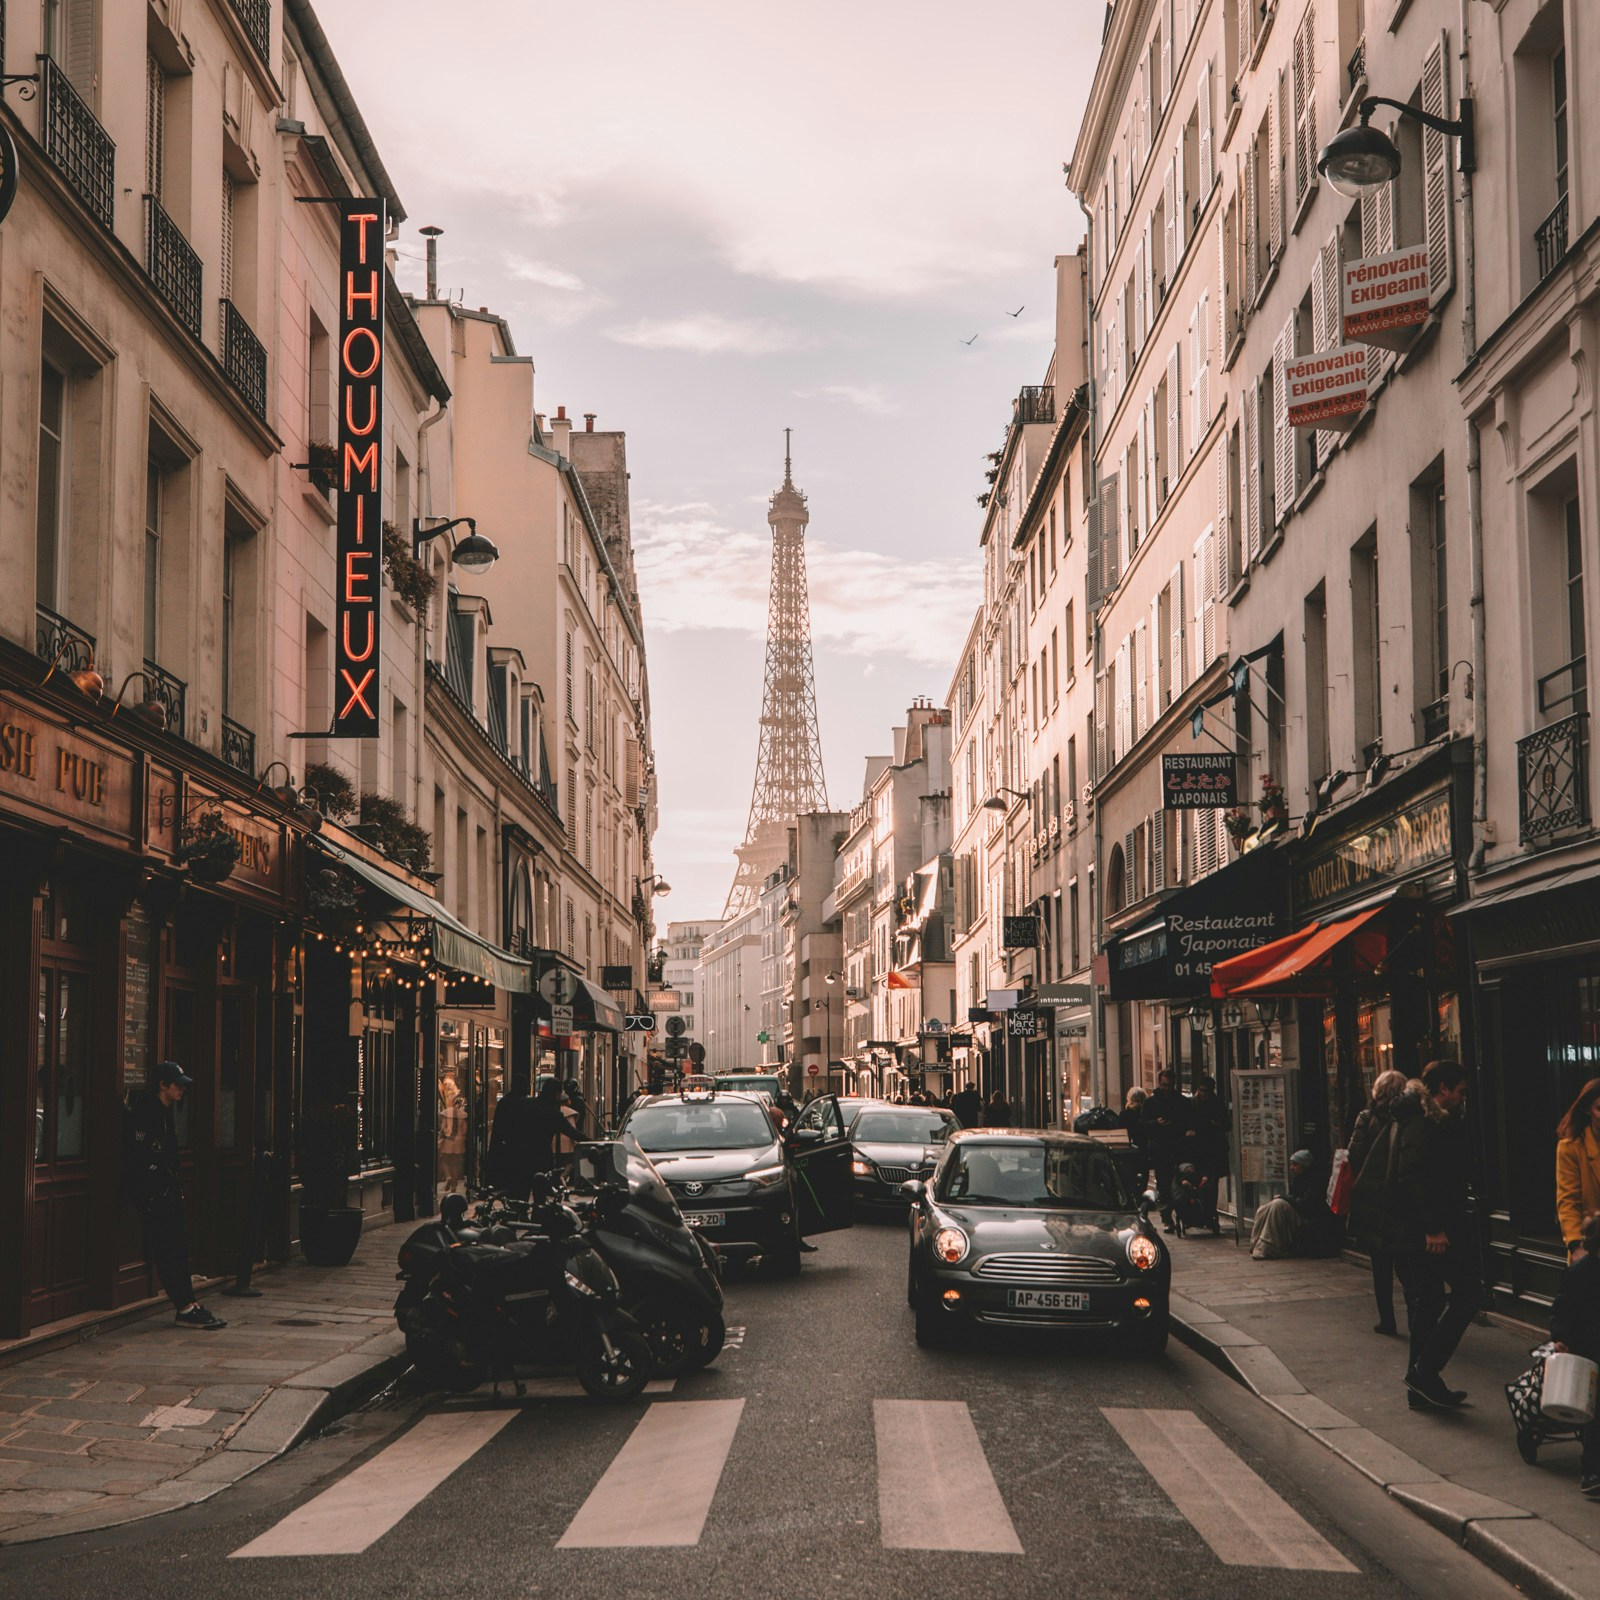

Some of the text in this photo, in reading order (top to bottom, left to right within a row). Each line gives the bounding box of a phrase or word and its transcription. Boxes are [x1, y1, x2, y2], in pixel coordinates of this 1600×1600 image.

[1351, 271, 1429, 304] Exigeant
[1366, 311, 1381, 321] 09
[1383, 308, 1394, 317] 81
[1396, 304, 1410, 314] 02
[1413, 300, 1427, 311] 20
[1307, 402, 1320, 412] 09
[1322, 399, 1333, 408] 81
[1335, 396, 1347, 405] 02
[1349, 392, 1362, 402] 20
[339, 212, 380, 720] THOUMIEUX
[1164, 756, 1232, 769] RESTAURANT
[1167, 772, 1231, 790] とよたか
[1171, 791, 1228, 805] JAPONAIS
[1308, 852, 1350, 900] MOULIN
[1374, 834, 1395, 874] LA
[1010, 919, 1034, 929] Karl
[1167, 912, 1275, 932] Restaurant
[1005, 927, 1035, 937] Marc
[1006, 936, 1035, 945] John
[1179, 933, 1266, 957] Japonais
[1175, 962, 1212, 977] 01 45
[1040, 996, 1083, 1004] intimissimi
[1009, 1018, 1035, 1028] Marc
[1013, 1010, 1035, 1021] Karl
[1009, 1027, 1035, 1035] John
[1017, 1292, 1080, 1308] AP-456-EH
